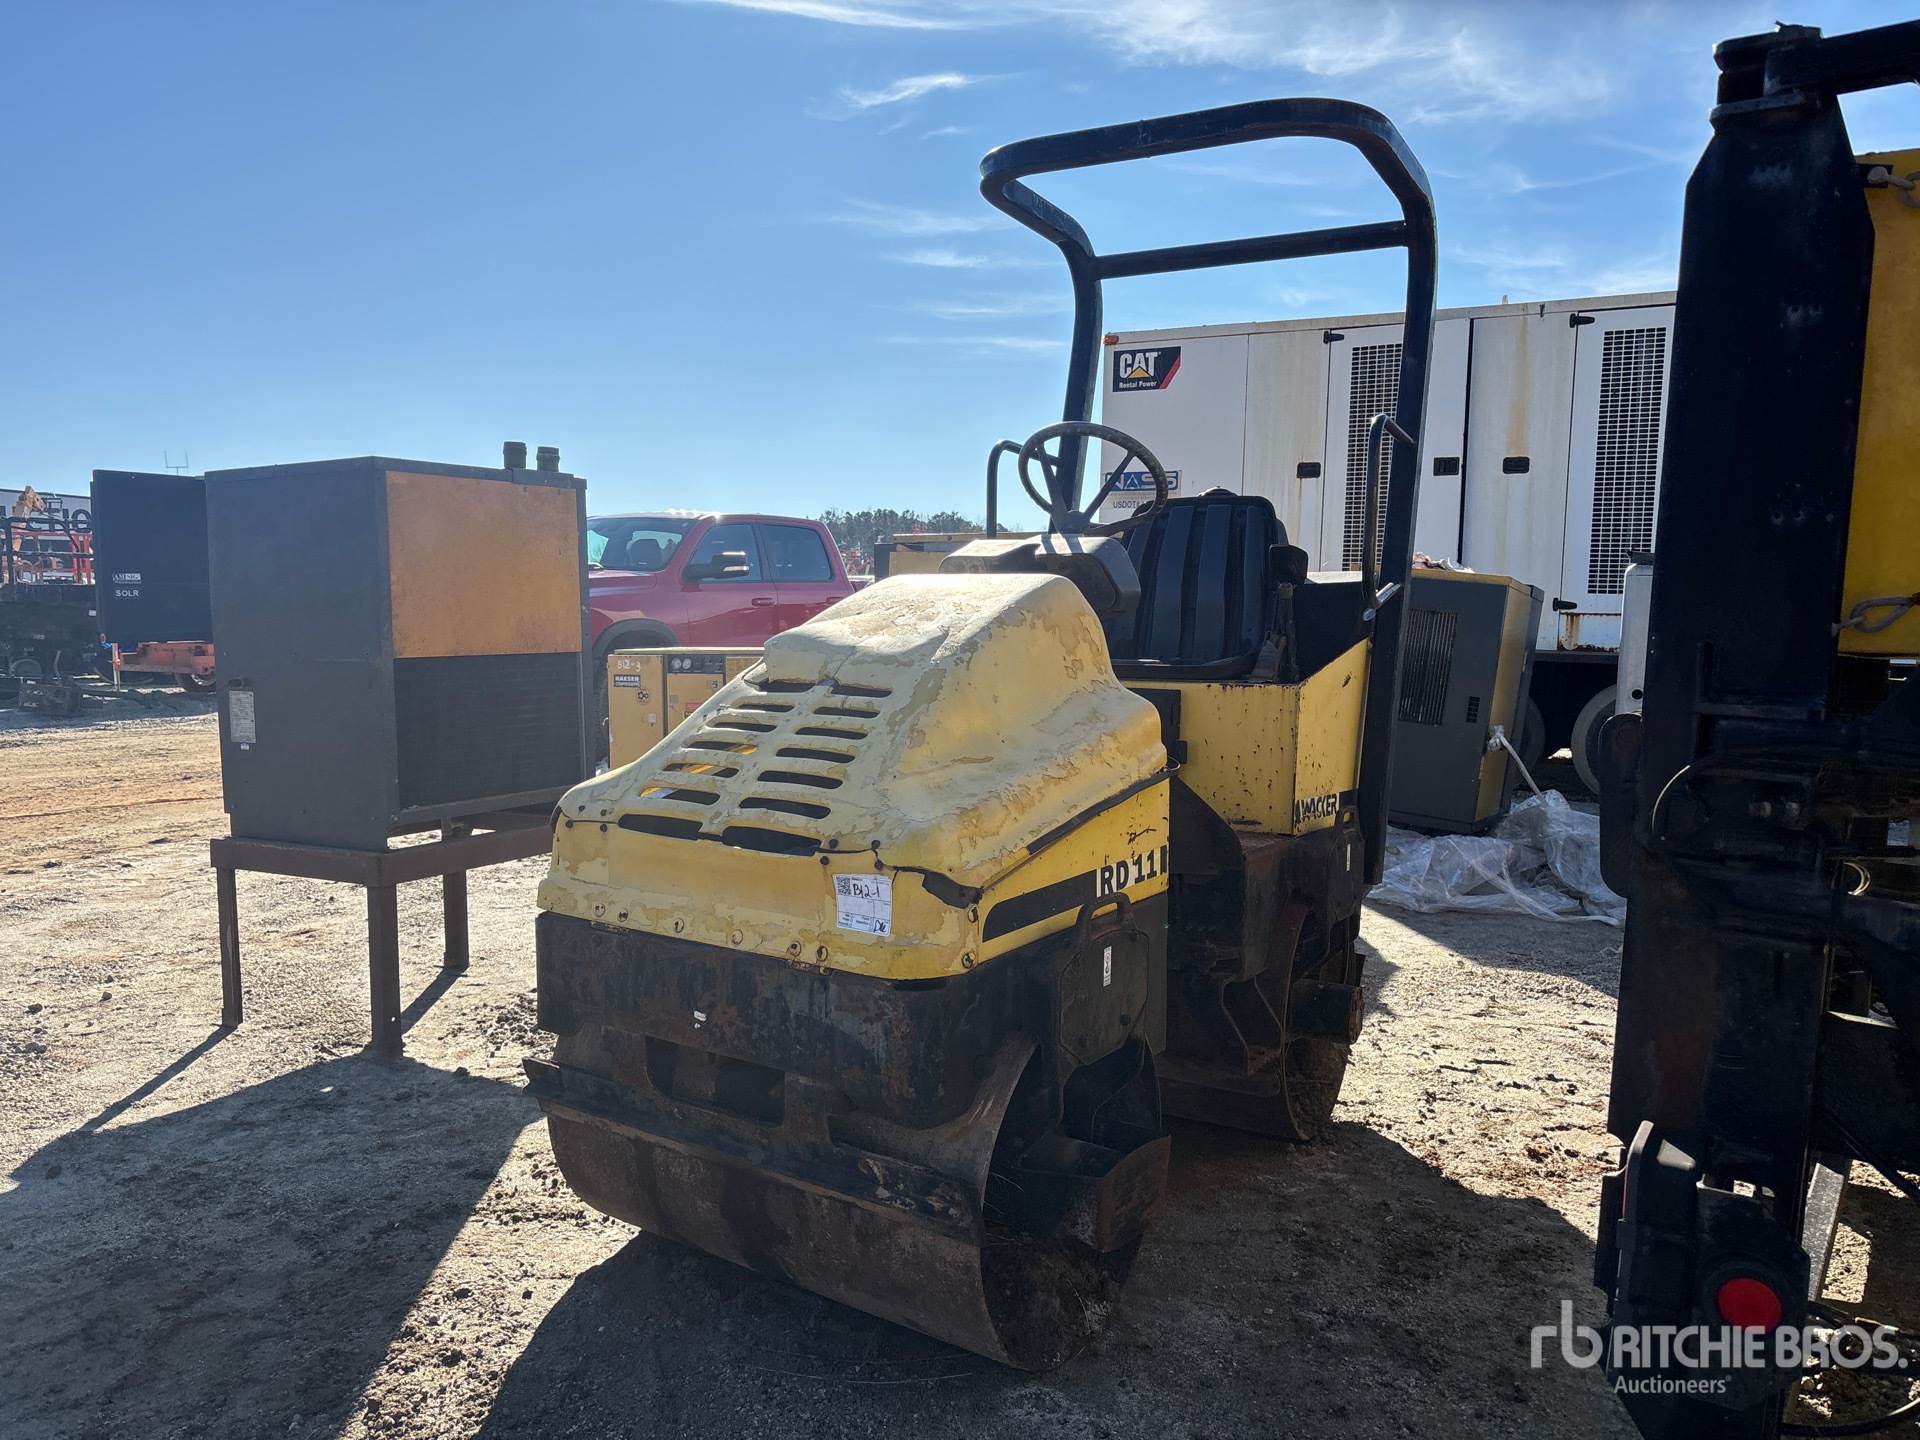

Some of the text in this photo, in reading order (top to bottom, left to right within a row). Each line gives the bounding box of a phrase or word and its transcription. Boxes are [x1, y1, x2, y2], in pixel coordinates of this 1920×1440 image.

[1119, 352, 1158, 378] CAT
[1119, 380, 1157, 389] Rental Power
[115, 589, 140, 597] SOLR
[1100, 859, 1130, 897] RD
